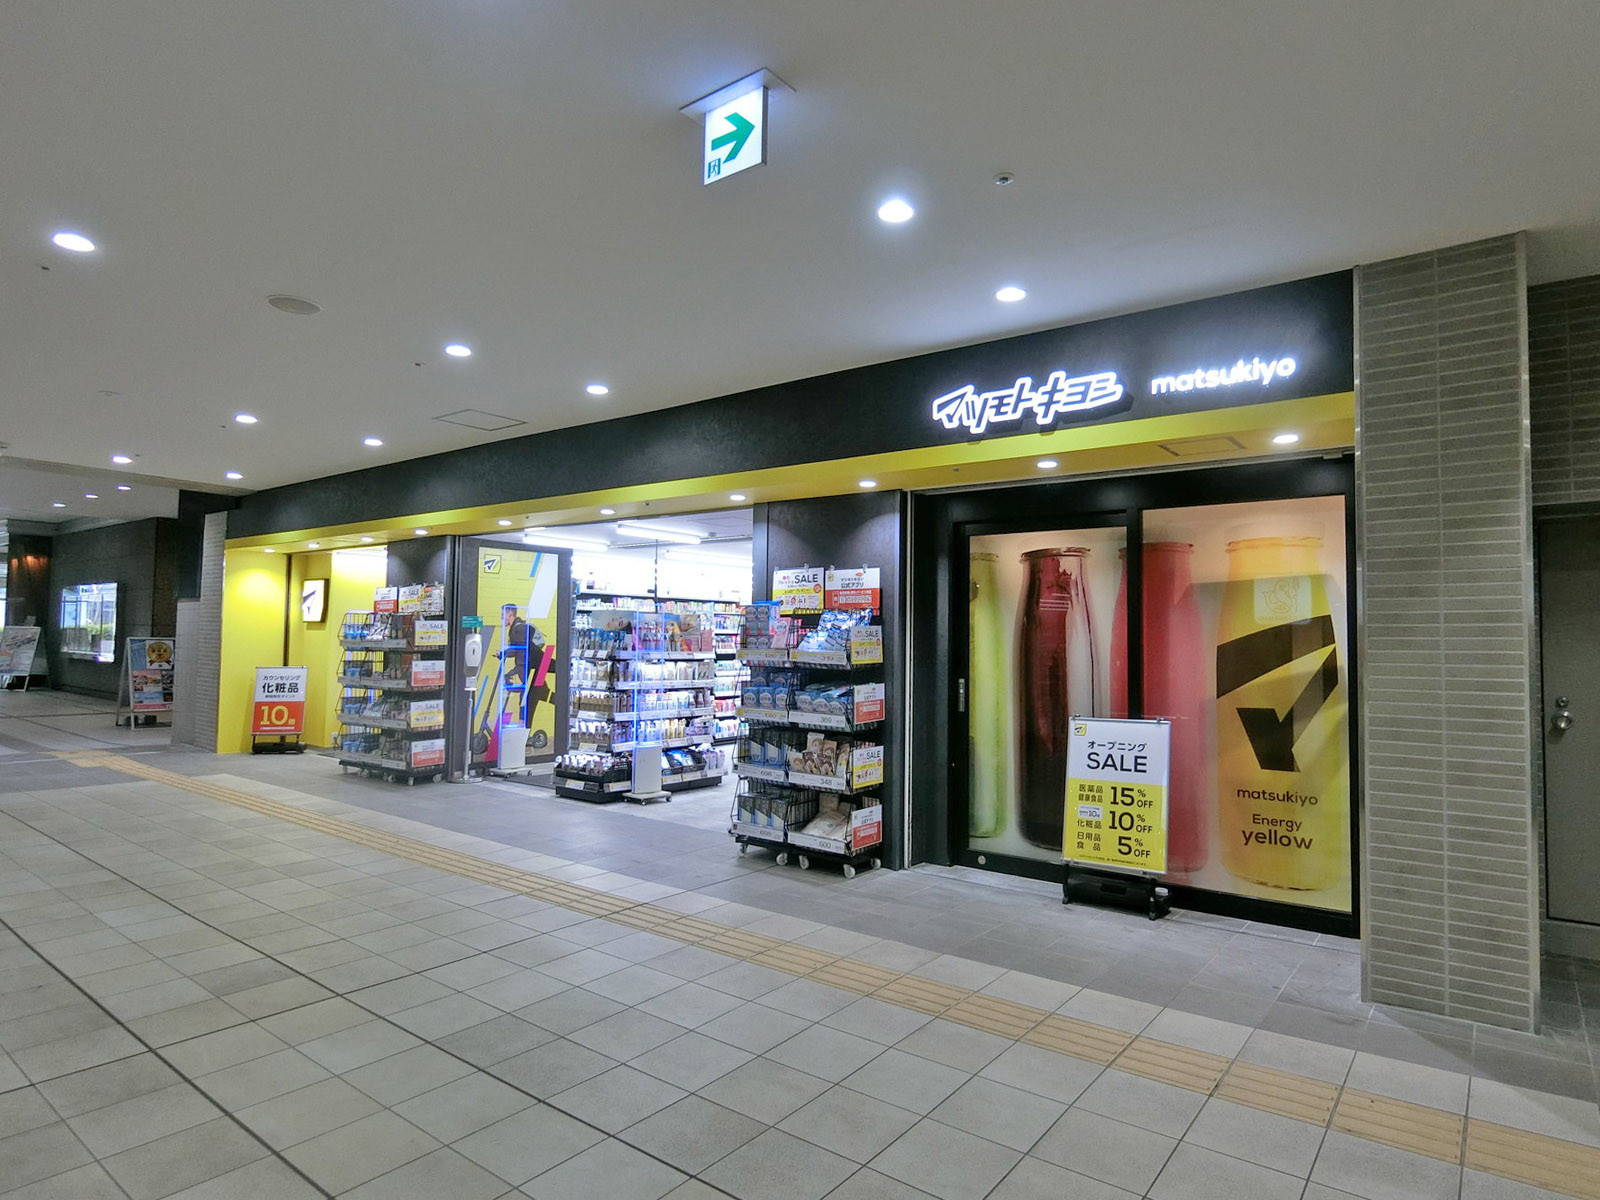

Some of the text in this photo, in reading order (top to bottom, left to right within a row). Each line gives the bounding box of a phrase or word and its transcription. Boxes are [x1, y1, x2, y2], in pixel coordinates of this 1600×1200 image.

[1151, 356, 1297, 396] matsukiyo
[794, 573, 819, 584] SALE
[864, 630, 879, 638] SALE
[262, 682, 299, 694] 化粧品
[1088, 740, 1148, 753] オープニング
[866, 750, 881, 761] SALE
[1086, 752, 1148, 774] SALE
[1079, 783, 1104, 794] 医薬品
[1236, 789, 1319, 807] matsukiyo
[1136, 800, 1154, 809] OFF
[1077, 819, 1102, 830] 化粧品
[1252, 813, 1302, 833] Energy
[1135, 824, 1153, 834] OFF
[1077, 831, 1101, 842] 日用品
[1241, 829, 1313, 850] yellow
[1133, 848, 1151, 858] OFF
